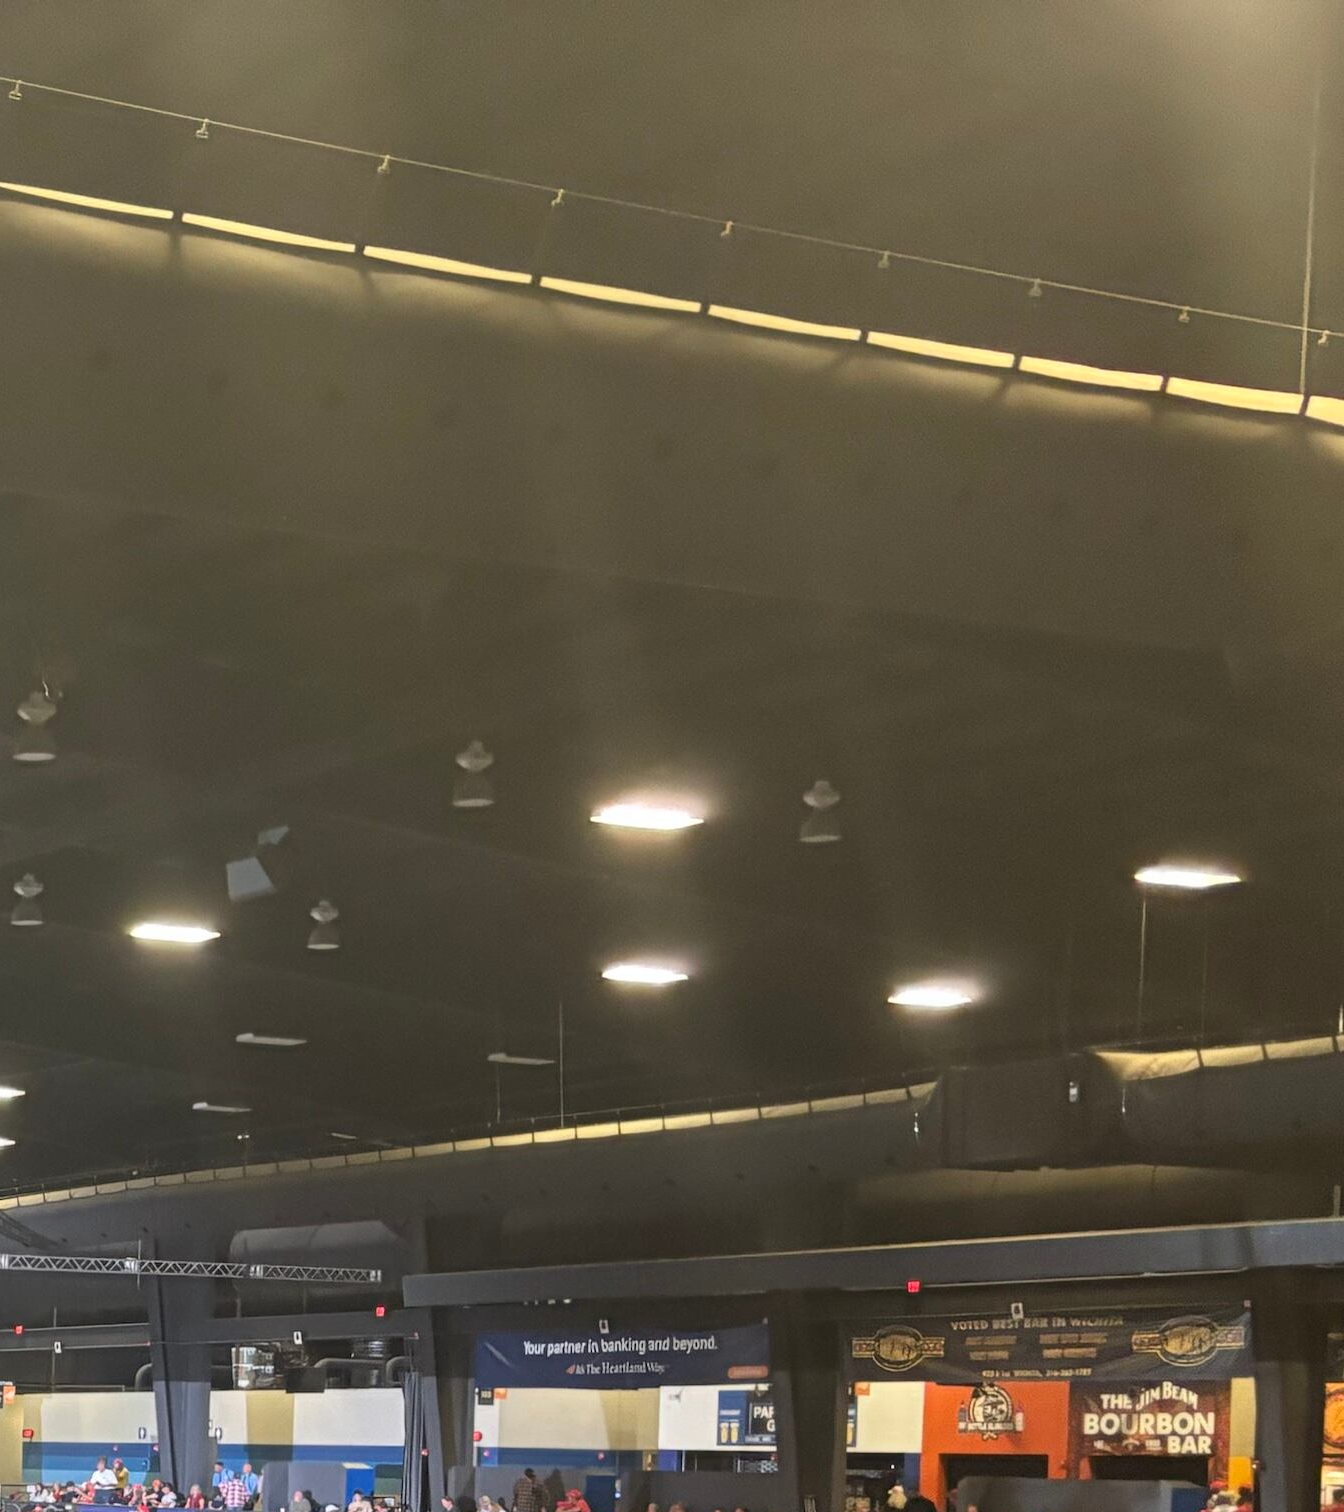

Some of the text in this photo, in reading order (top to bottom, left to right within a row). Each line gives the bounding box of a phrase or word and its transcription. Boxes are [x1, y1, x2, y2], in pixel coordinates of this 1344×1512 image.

[523, 1335, 718, 1358] Your partner in banking and beyond.
[602, 1361, 646, 1374] Heartland
[1100, 1394, 1133, 1409] THE
[1162, 1381, 1199, 1410] BEAM
[1083, 1412, 1215, 1436] BOURBON
[1167, 1435, 1212, 1454] BAR
